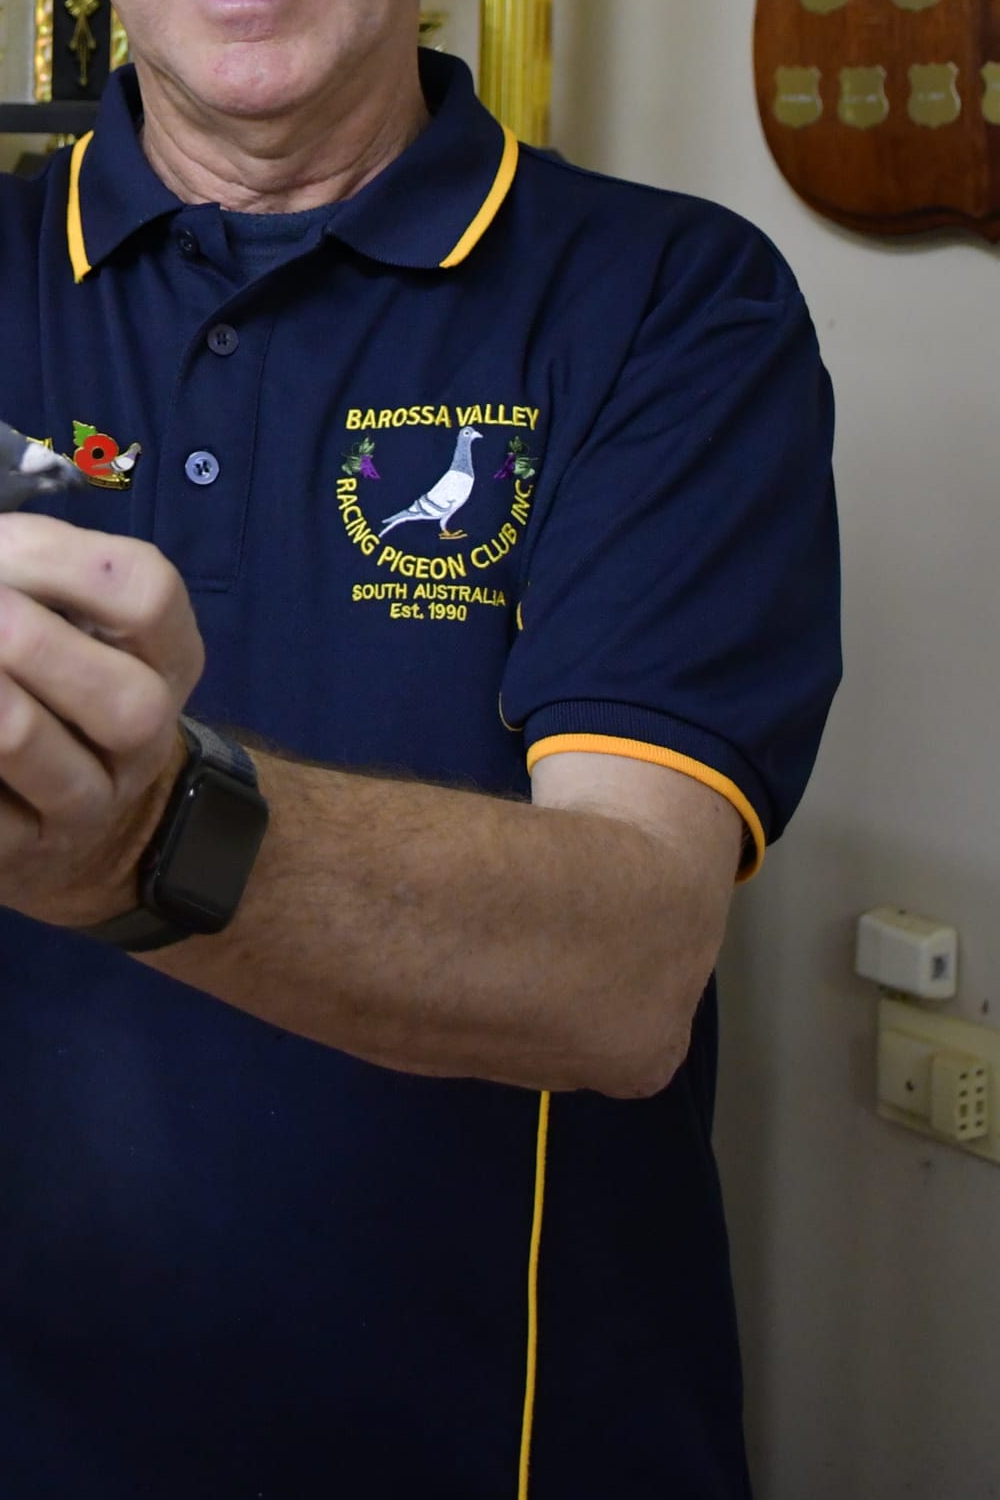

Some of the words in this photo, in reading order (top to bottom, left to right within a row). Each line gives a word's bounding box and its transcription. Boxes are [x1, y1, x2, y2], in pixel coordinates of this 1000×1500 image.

[346, 405, 452, 430] BAROSSA
[456, 403, 539, 430] VALLEY
[336, 478, 380, 555] RACING
[377, 546, 466, 579] PIGEON
[470, 522, 518, 568] CLUB
[352, 583, 408, 601] SOUTH
[413, 583, 506, 606] AUSTRALIA
[390, 603, 424, 619] Est.
[428, 603, 467, 621] 1990
